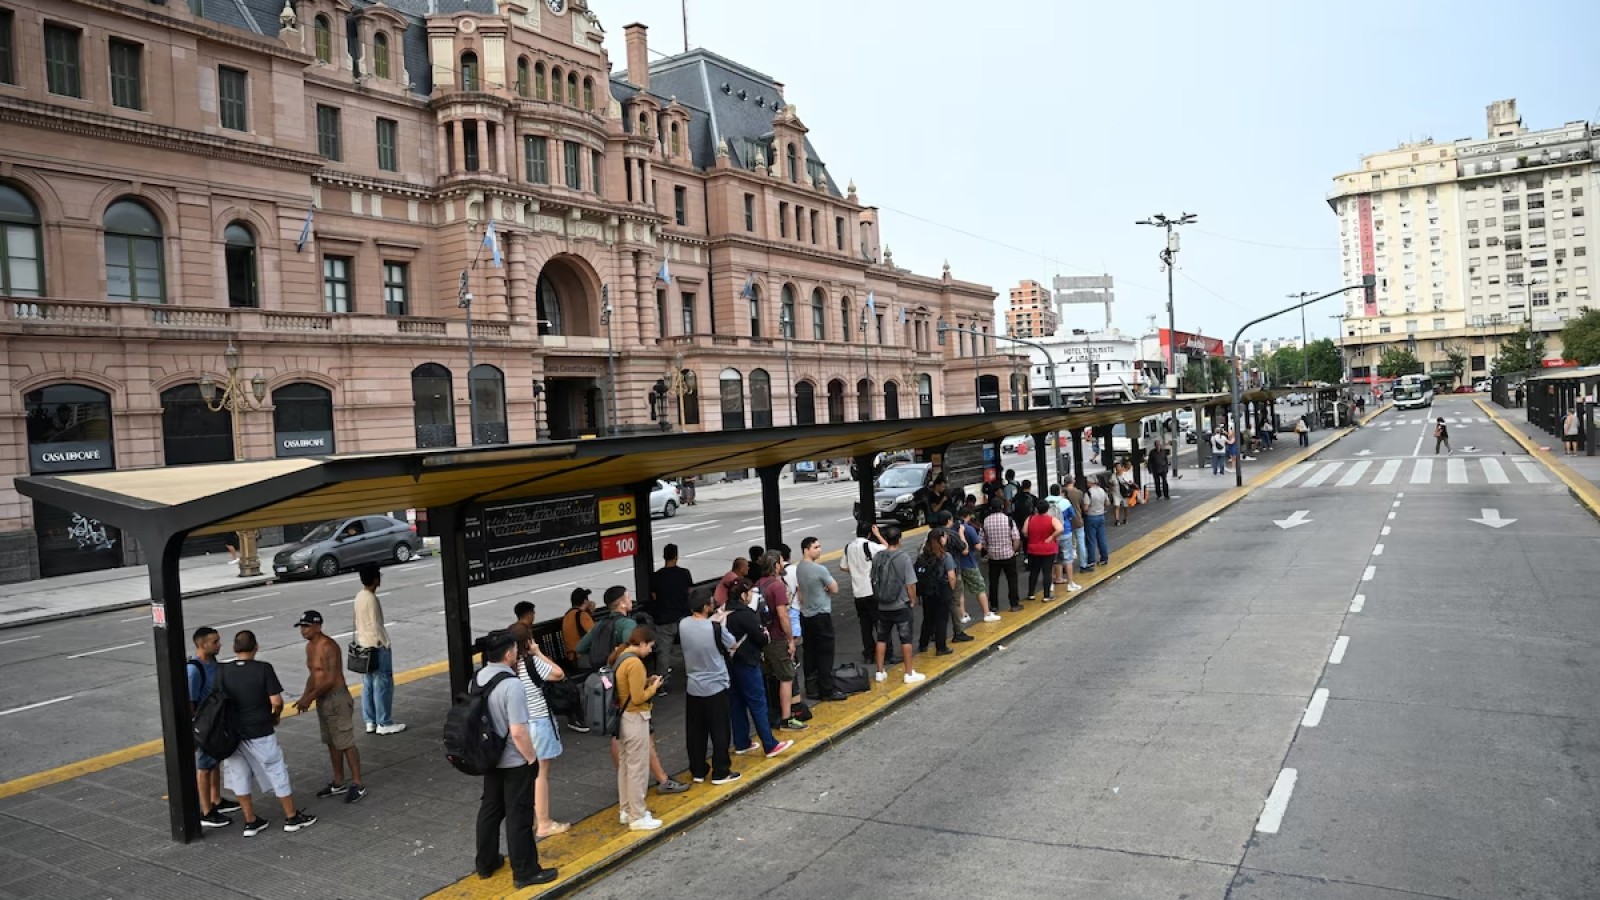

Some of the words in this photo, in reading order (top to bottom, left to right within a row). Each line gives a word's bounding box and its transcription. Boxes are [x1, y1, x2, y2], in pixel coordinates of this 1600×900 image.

[1063, 347, 1082, 355] HOTEL
[283, 439, 299, 449] CASA
[42, 452, 64, 462] CASA
[78, 449, 100, 460] CAFÉ
[618, 503, 632, 516] 98
[616, 537, 635, 554] 100
